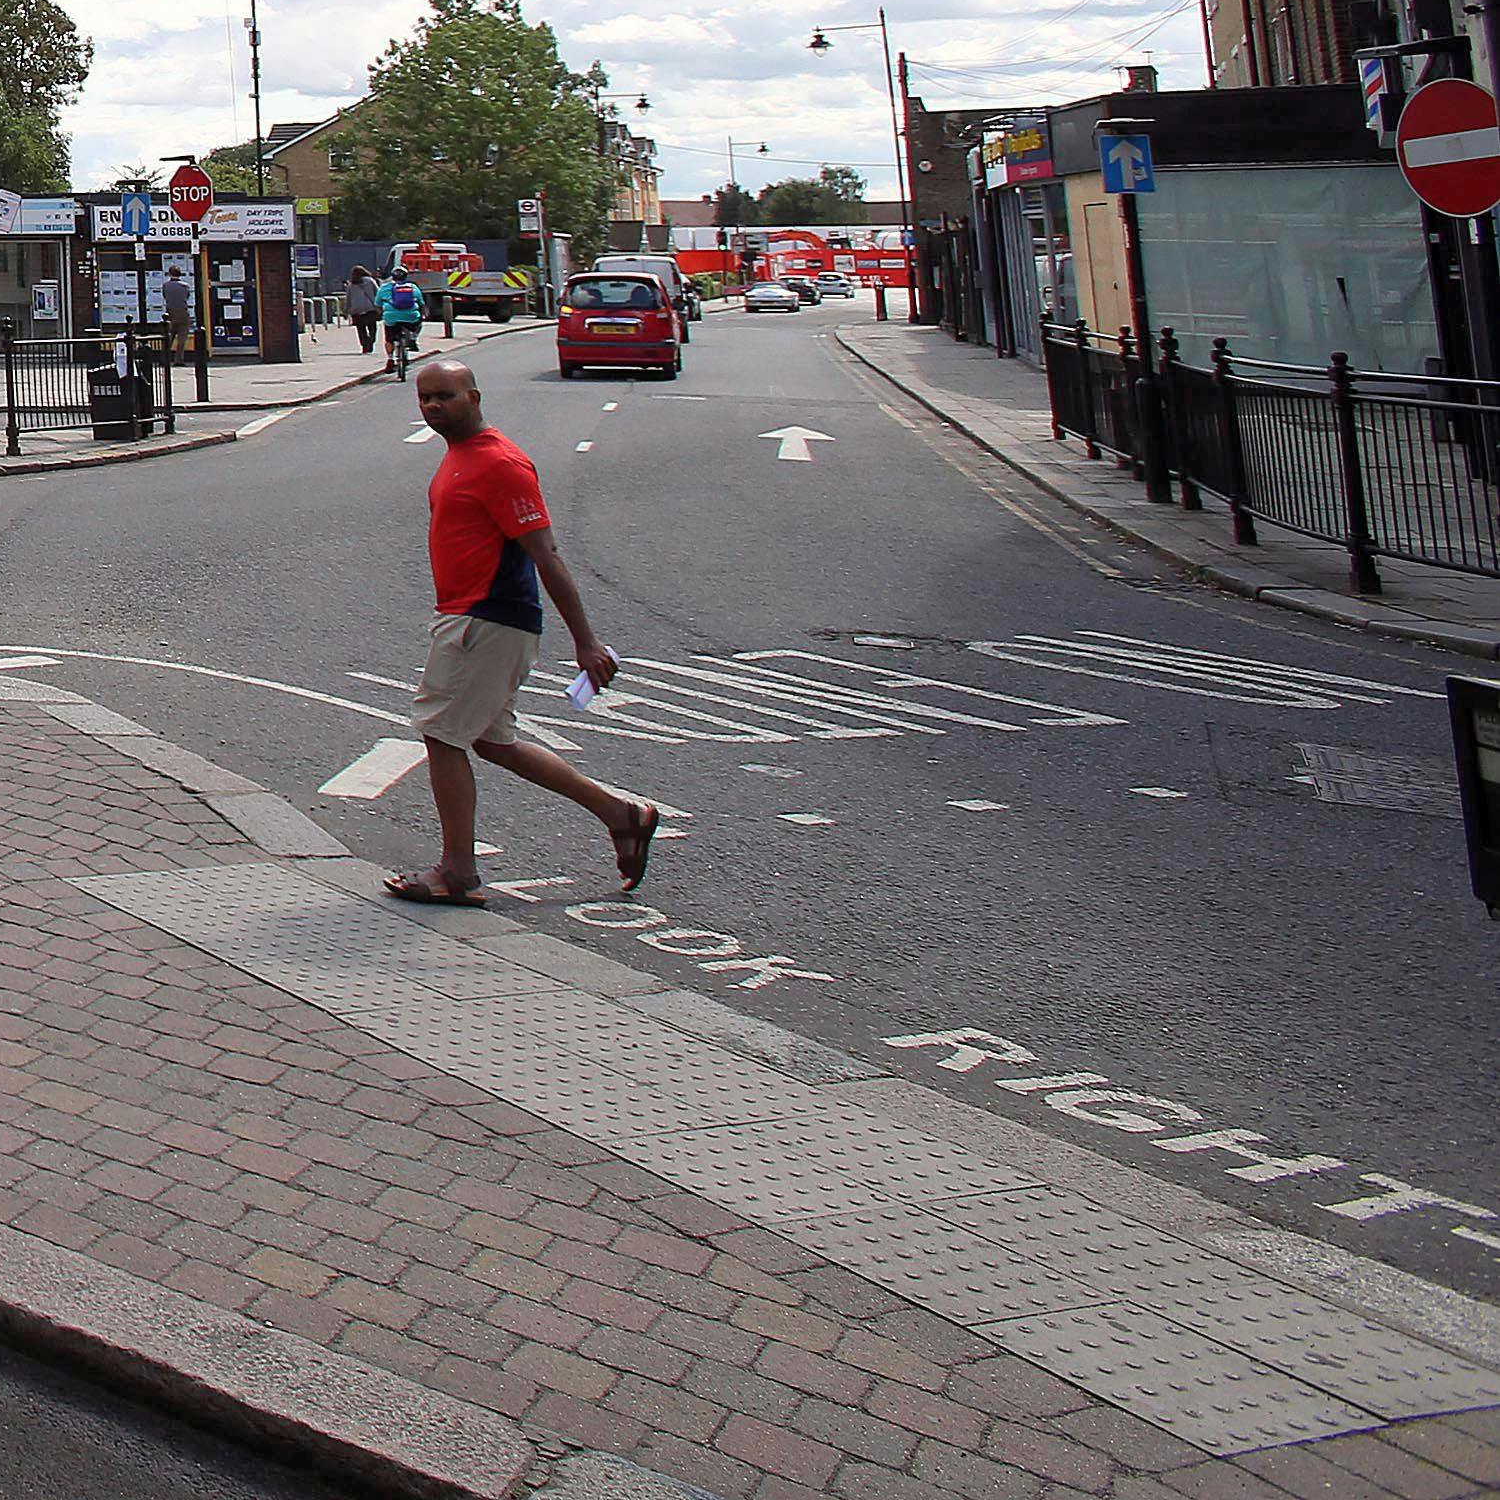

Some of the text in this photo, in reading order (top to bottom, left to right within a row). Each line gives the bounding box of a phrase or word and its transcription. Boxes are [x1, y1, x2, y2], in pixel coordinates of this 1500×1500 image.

[172, 186, 210, 202] STOP
[246, 209, 262, 217] DAY
[161, 226, 192, 237] 0688
[244, 228, 269, 236] COACH
[270, 228, 288, 236] HIRE
[965, 629, 1448, 709] NO
[486, 875, 1500, 1222] LOOK RIGHT
